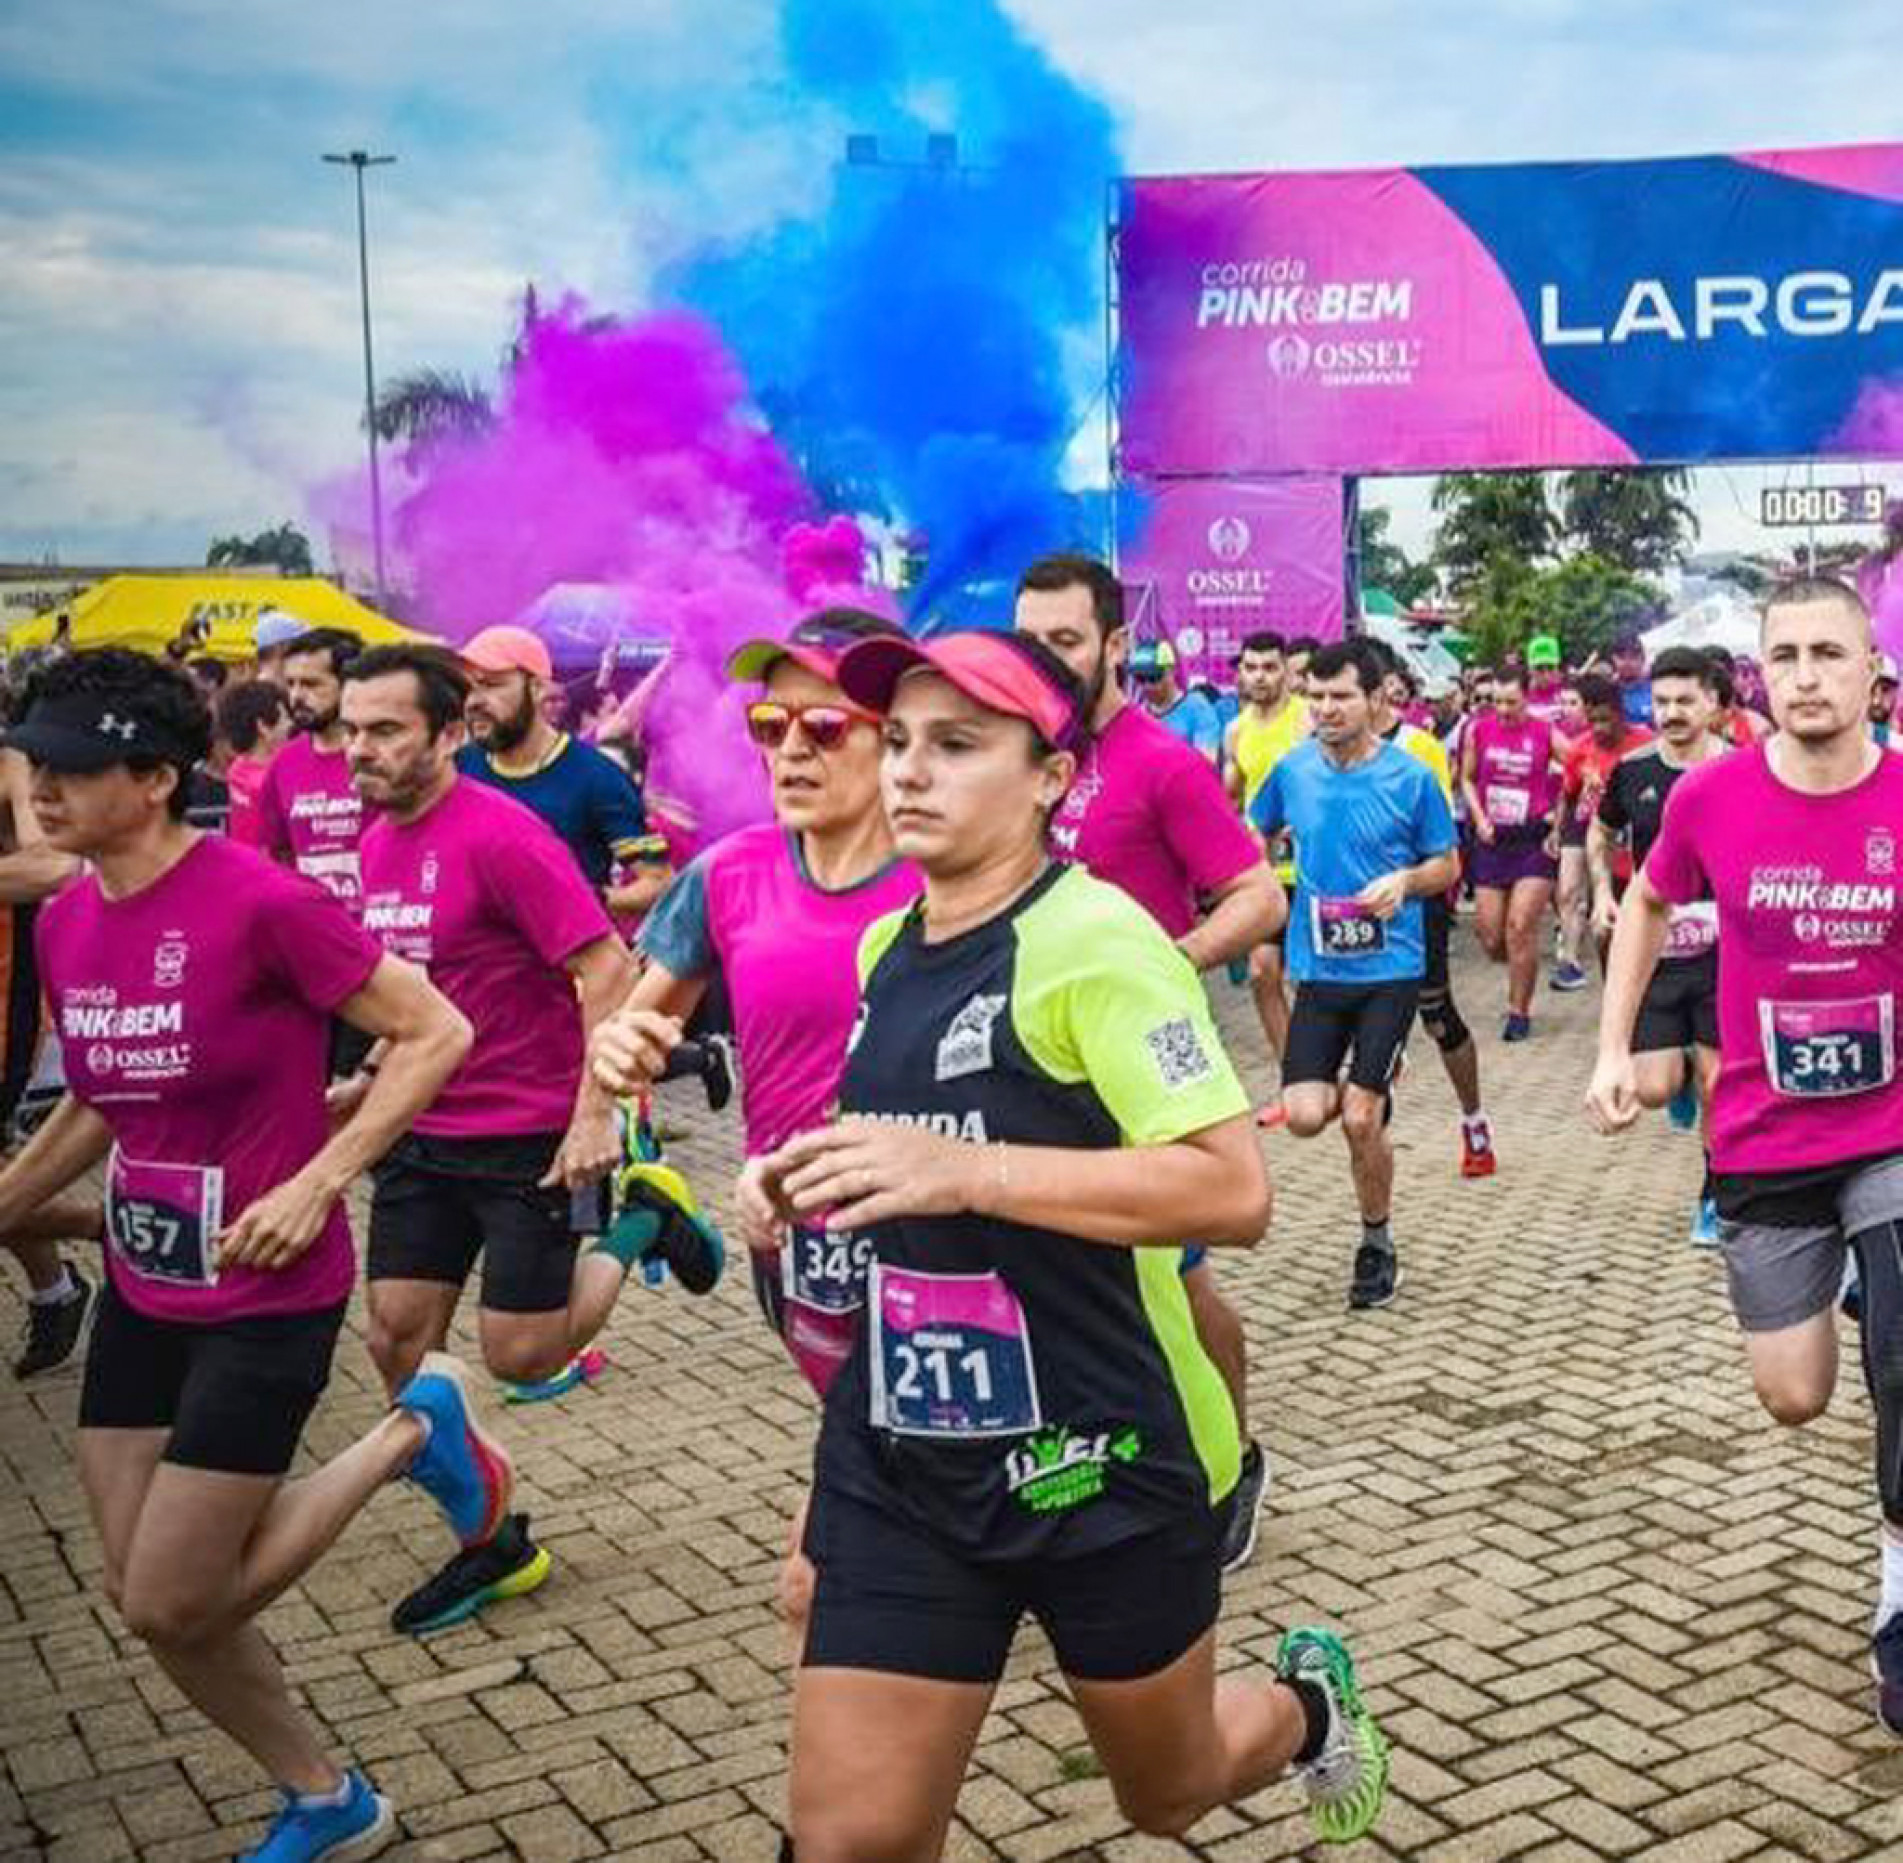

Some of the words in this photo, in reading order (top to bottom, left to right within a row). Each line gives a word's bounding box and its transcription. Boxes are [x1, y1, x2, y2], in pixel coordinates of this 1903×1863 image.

[1201, 257, 1306, 285] corrida
[1541, 268, 1903, 346] LARGA
[1314, 340, 1419, 368] OSSEL
[1186, 570, 1270, 593] OSSEL
[1792, 1042, 1863, 1076] 341
[118, 1206, 180, 1256] 157
[895, 1344, 992, 1401] 211
